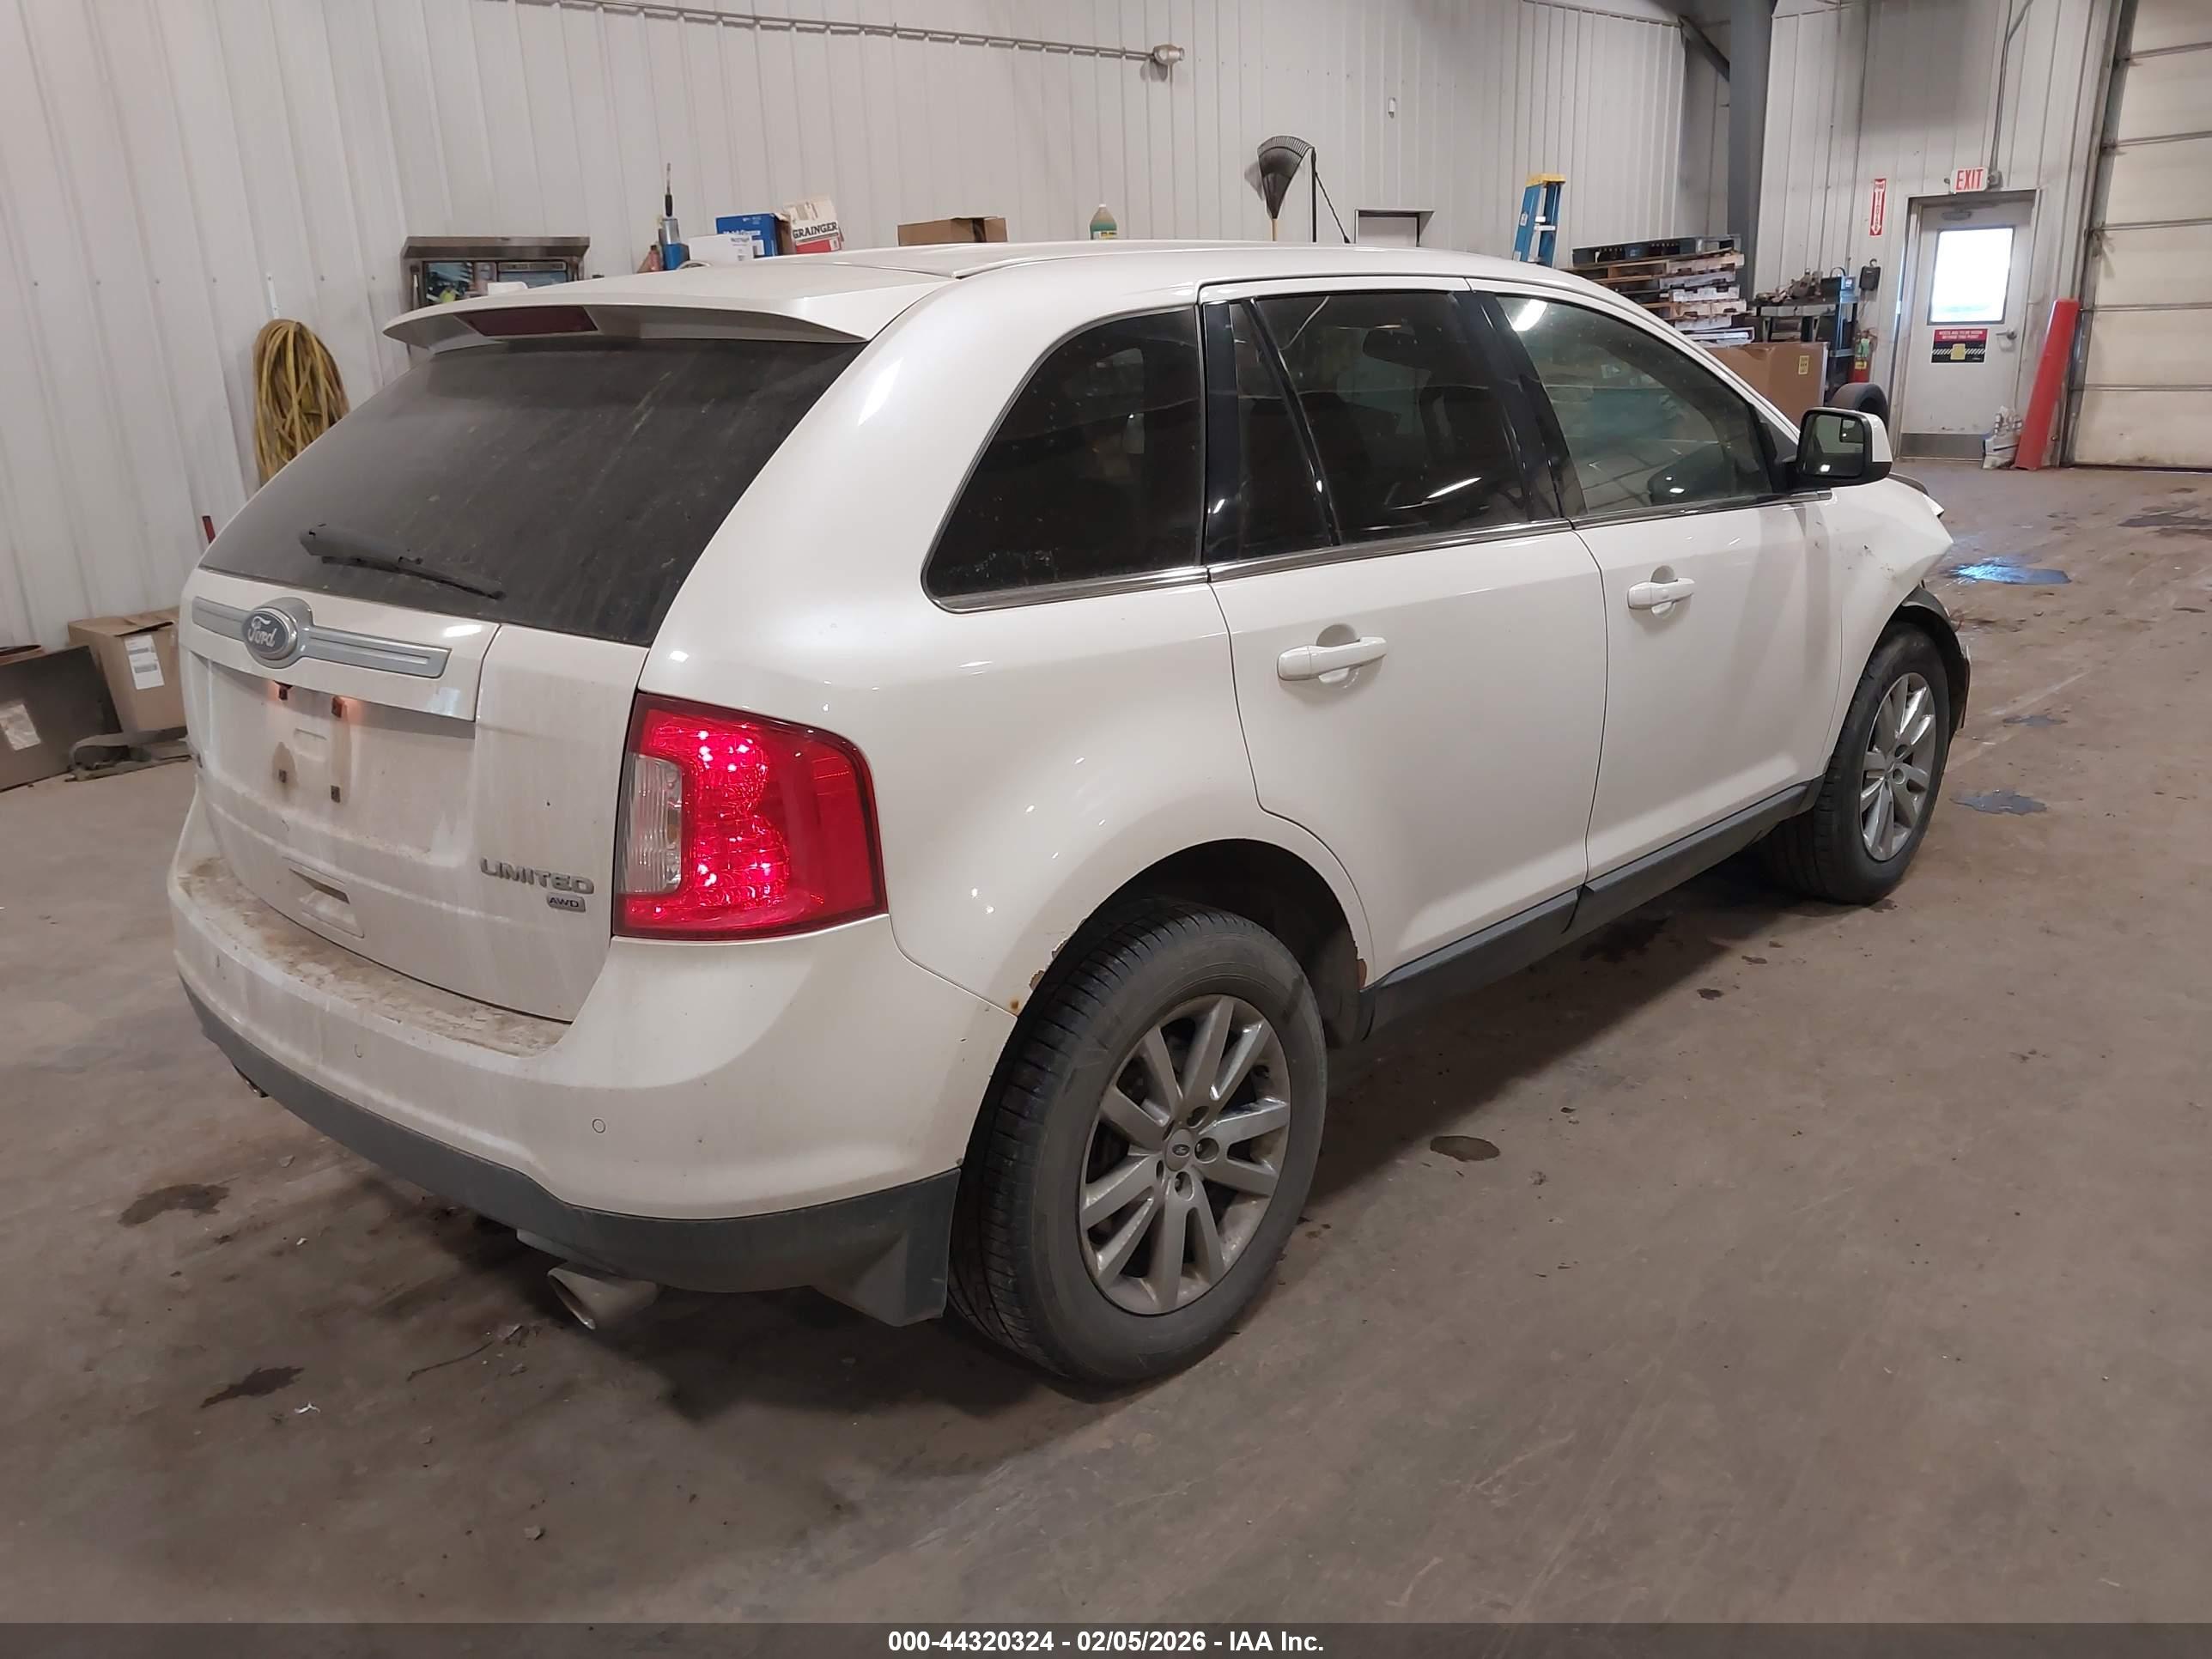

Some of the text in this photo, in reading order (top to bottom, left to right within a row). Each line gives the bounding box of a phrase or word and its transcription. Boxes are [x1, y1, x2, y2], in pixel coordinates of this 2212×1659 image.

[1955, 168, 1984, 191] EXIT
[793, 222, 837, 240] GRAINGER
[247, 616, 277, 647] Ford
[480, 857, 595, 895] LIMITED
[549, 896, 580, 908] AWD
